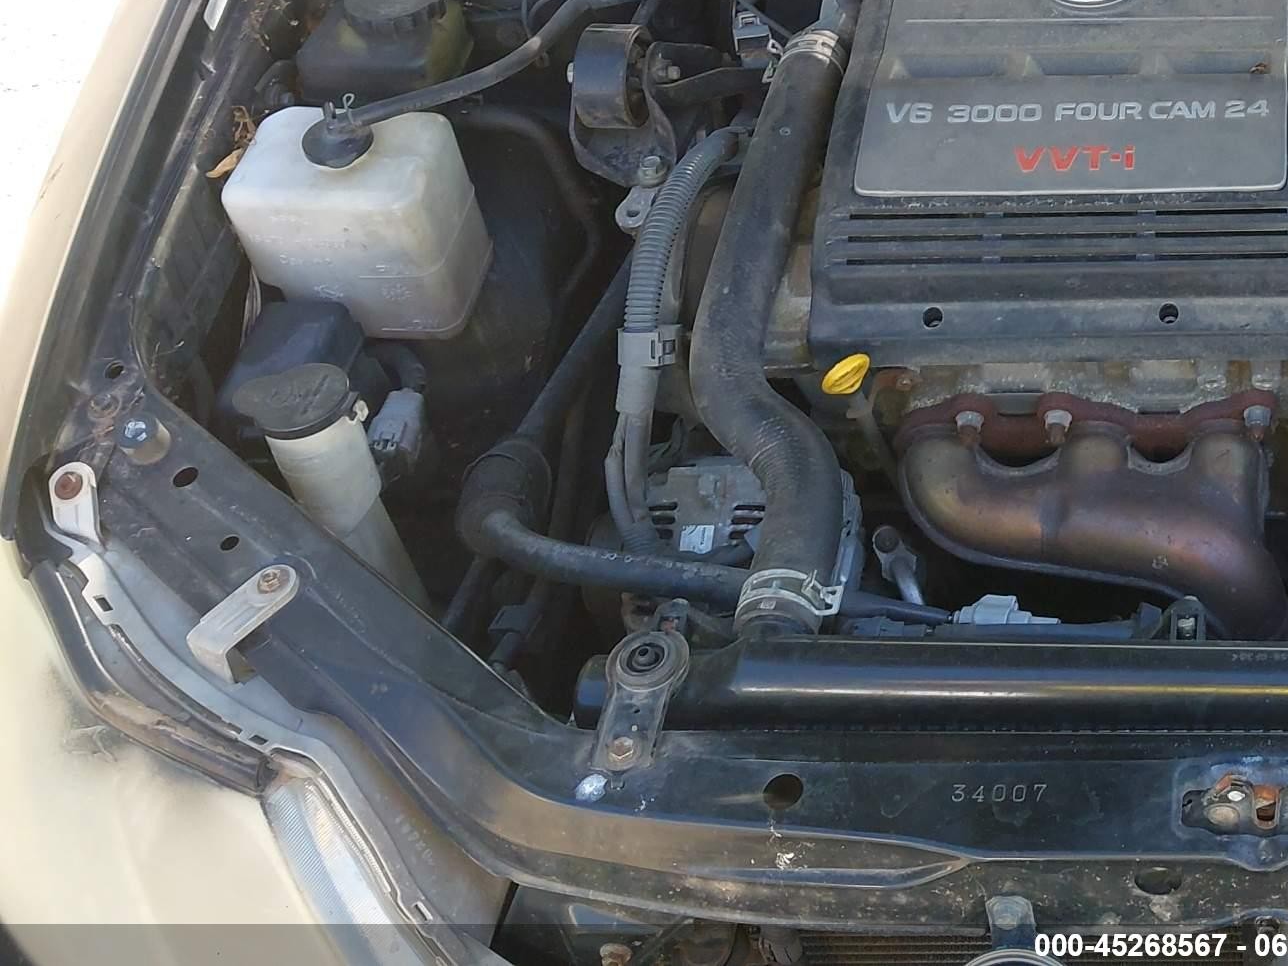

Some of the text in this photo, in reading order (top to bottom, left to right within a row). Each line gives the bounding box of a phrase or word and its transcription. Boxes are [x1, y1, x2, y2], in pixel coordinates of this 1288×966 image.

[886, 99, 1270, 124] V6 3000 FOUR CAM 24
[1014, 145, 1136, 172] VVT-i
[951, 784, 1048, 802] 34007
